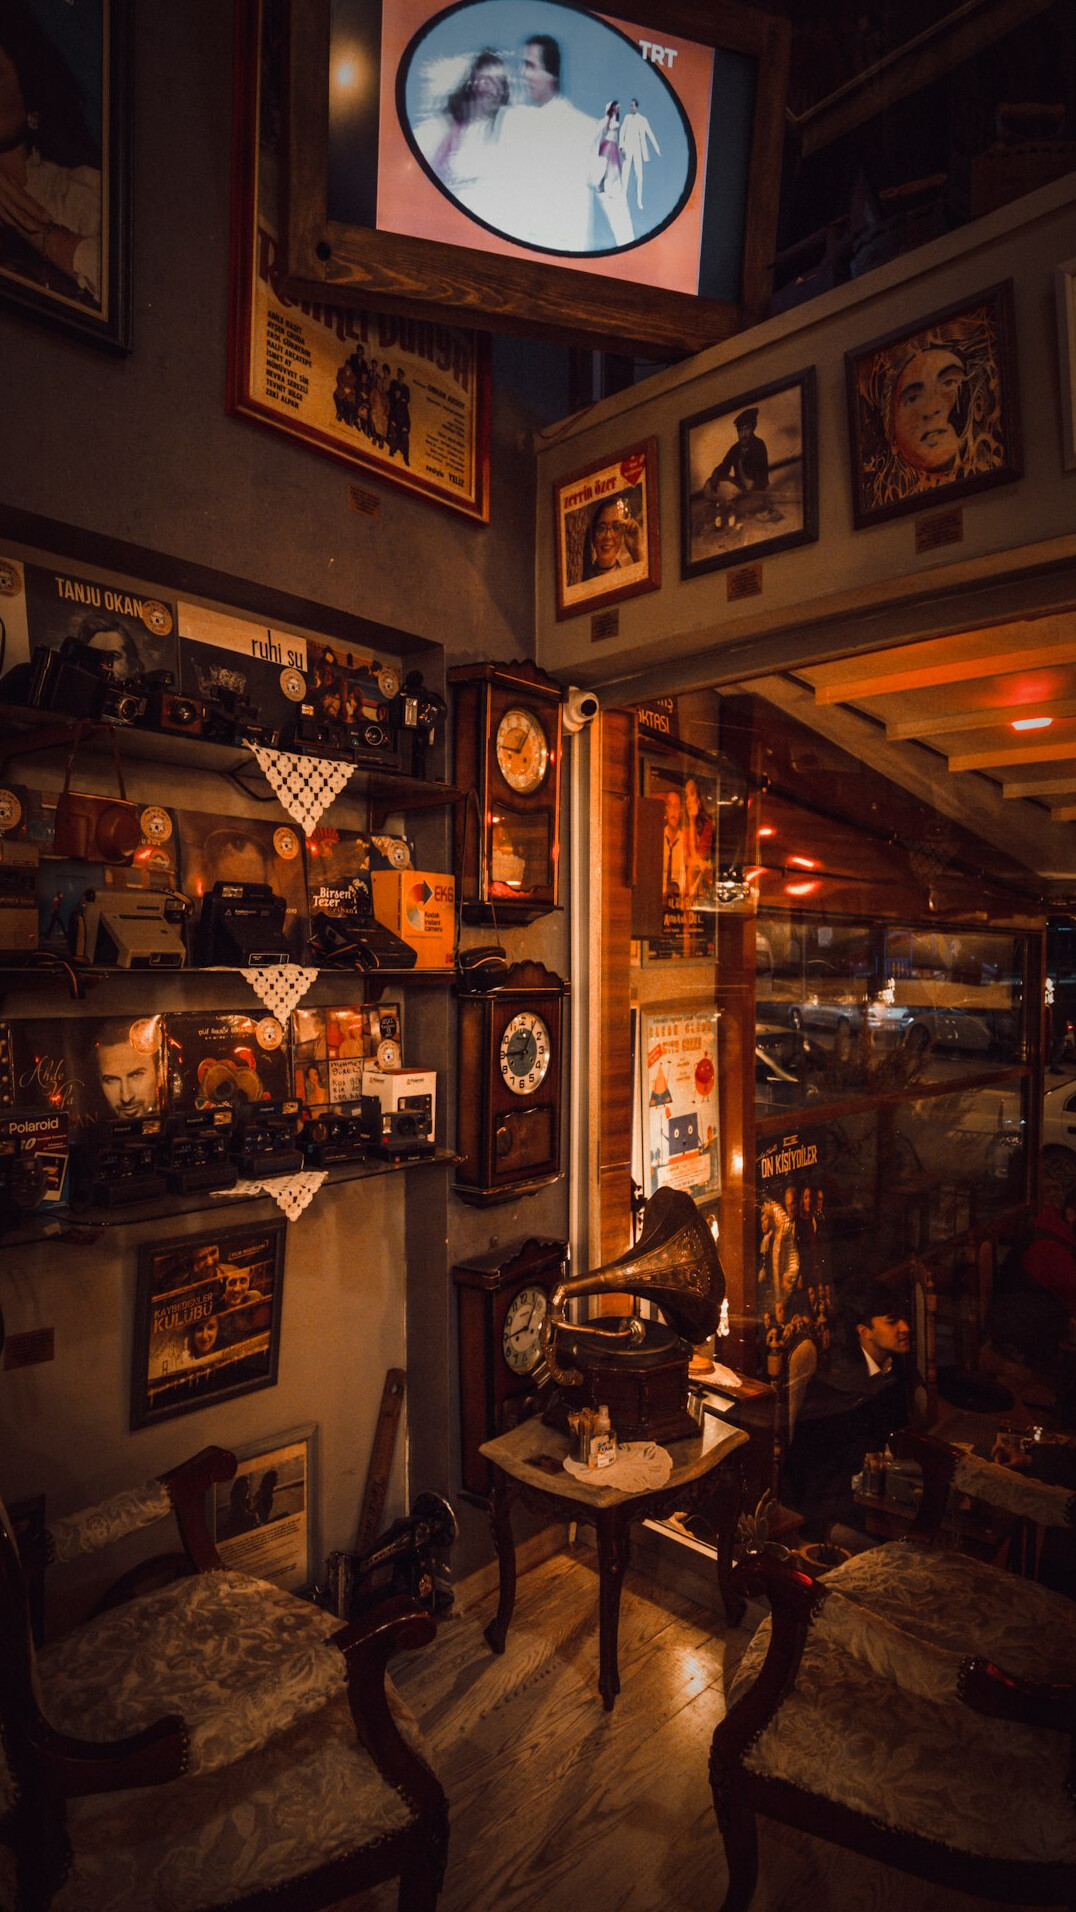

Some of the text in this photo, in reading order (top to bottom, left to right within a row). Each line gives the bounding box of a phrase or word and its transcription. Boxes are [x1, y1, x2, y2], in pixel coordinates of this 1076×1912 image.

[638, 39, 678, 68] TRT
[281, 395, 299, 409] ALPAN
[55, 576, 144, 619] TANJU OKAN
[251, 629, 303, 669] ruhi su
[313, 895, 341, 908] Tezer
[320, 887, 352, 899] Birsen
[8, 1117, 59, 1135] Polaroid
[761, 1155, 774, 1178] ON
[153, 1292, 213, 1319] KAYBEDENLER
[153, 1301, 213, 1334] KULÜBÜ
